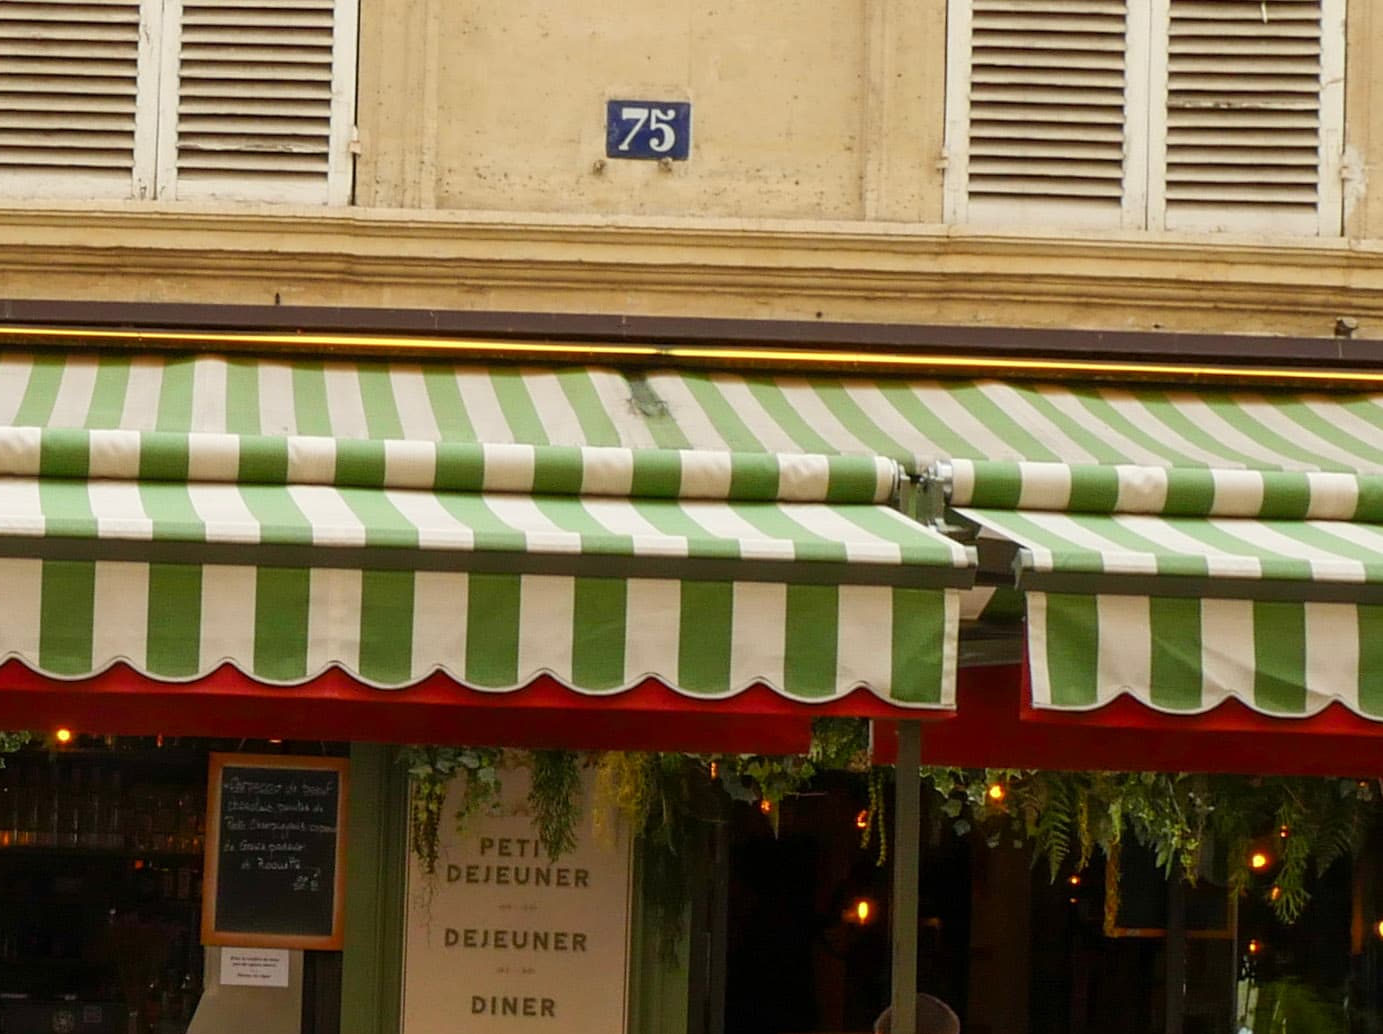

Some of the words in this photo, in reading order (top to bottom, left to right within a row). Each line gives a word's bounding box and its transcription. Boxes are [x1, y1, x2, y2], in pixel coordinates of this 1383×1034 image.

[618, 107, 676, 152] 75
[446, 864, 590, 888] DEJEUNER
[444, 928, 587, 952] DEJEUNER
[471, 996, 556, 1018] DINER
